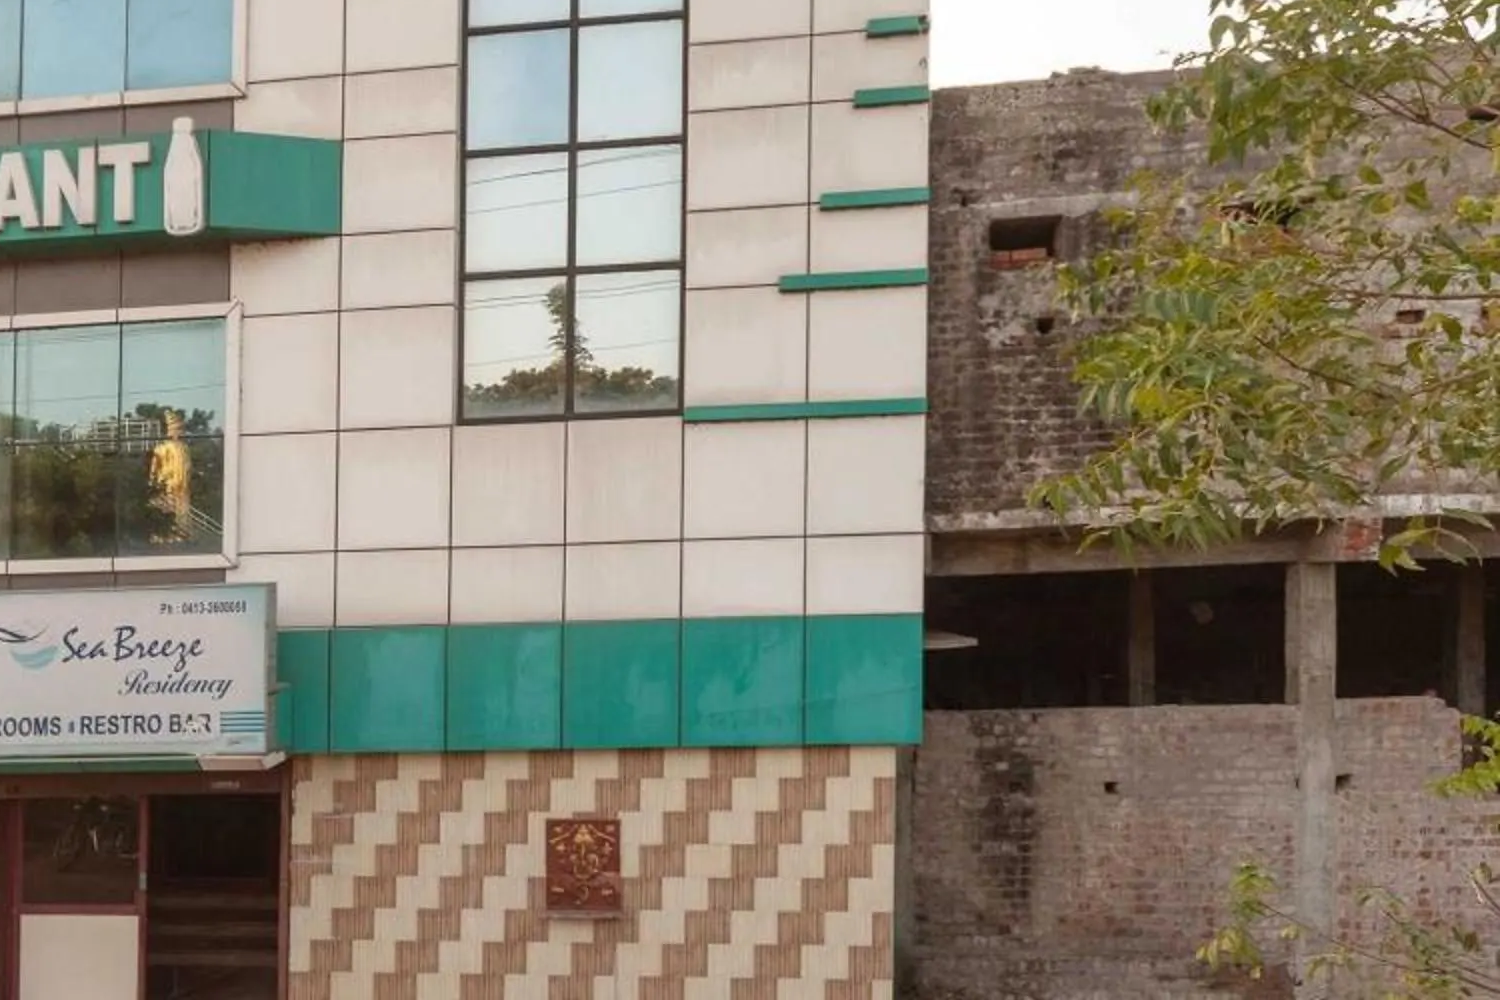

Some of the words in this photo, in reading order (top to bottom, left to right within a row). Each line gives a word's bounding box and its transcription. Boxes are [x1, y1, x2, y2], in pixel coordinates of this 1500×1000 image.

[62, 626, 108, 663] Sea
[114, 625, 204, 672] Breeze
[117, 670, 233, 700] Residency
[79, 714, 162, 735] RESTRO
[169, 713, 212, 733] BAR
